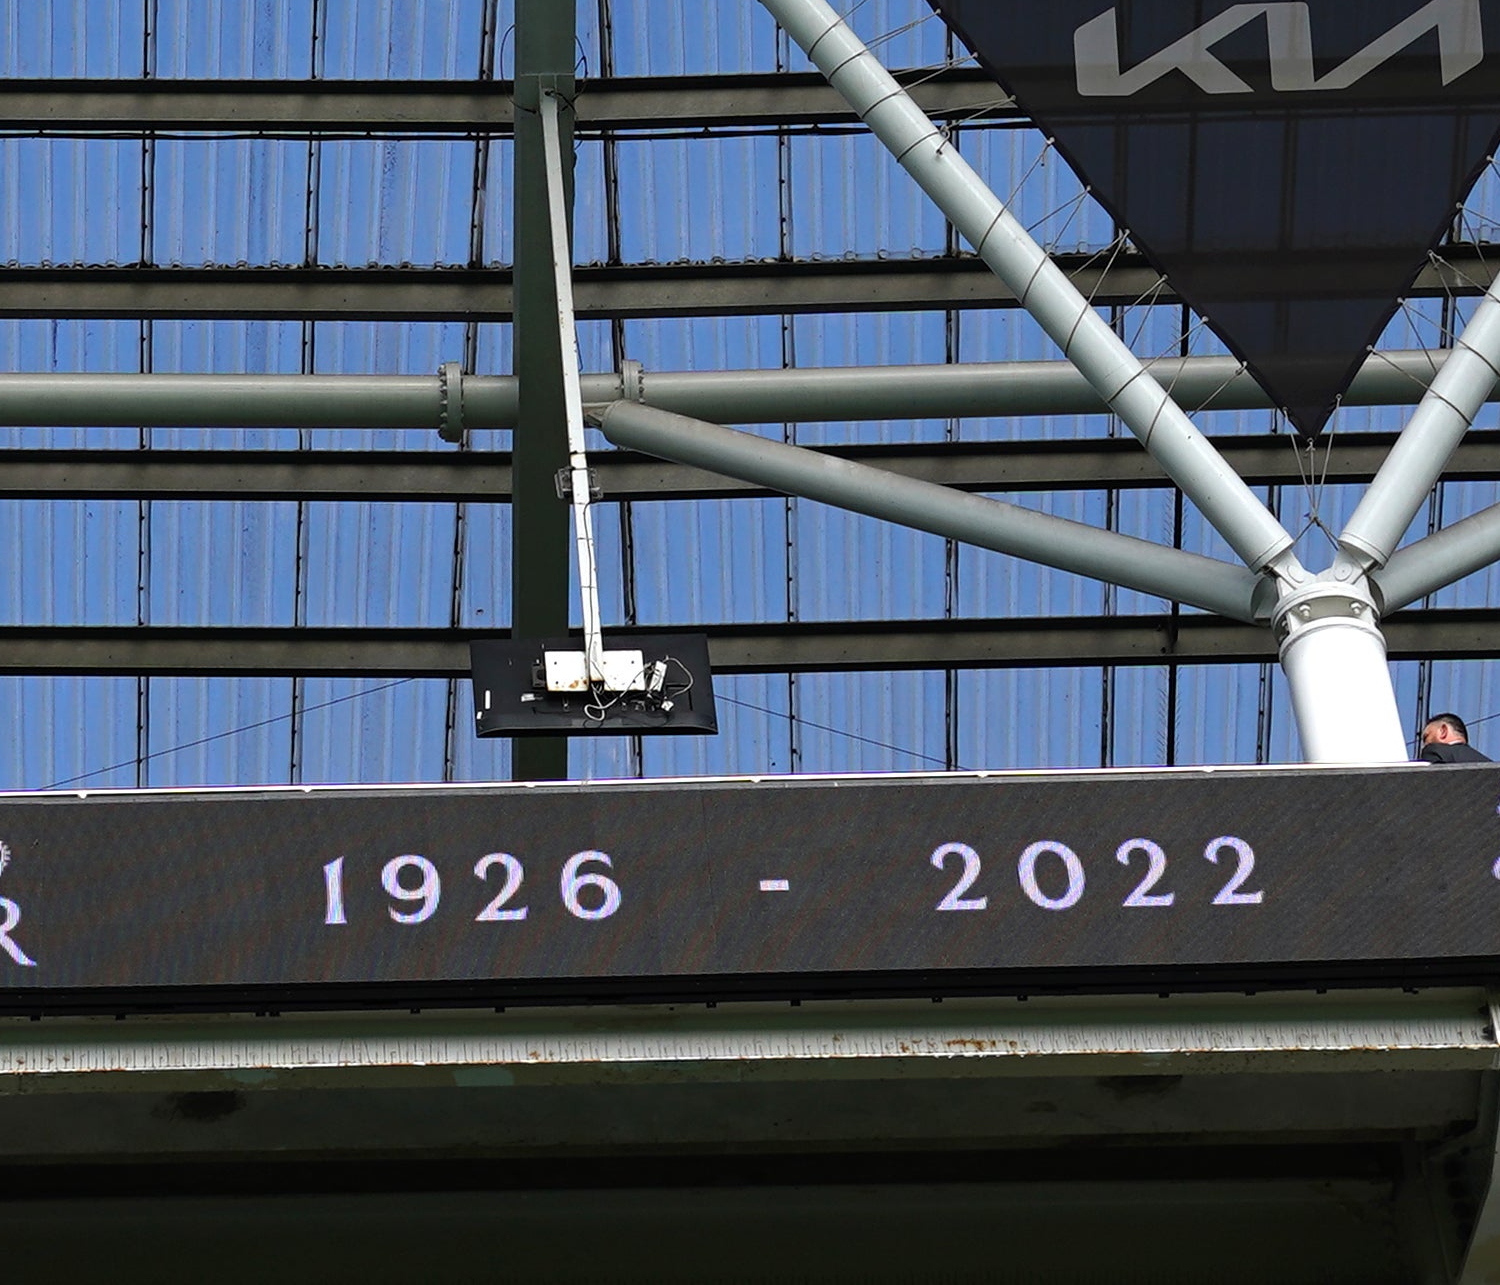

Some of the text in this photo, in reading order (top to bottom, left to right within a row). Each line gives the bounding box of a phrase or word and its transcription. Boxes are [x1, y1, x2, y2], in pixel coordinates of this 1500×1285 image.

[322, 835, 1266, 926] 1926 - 2022
